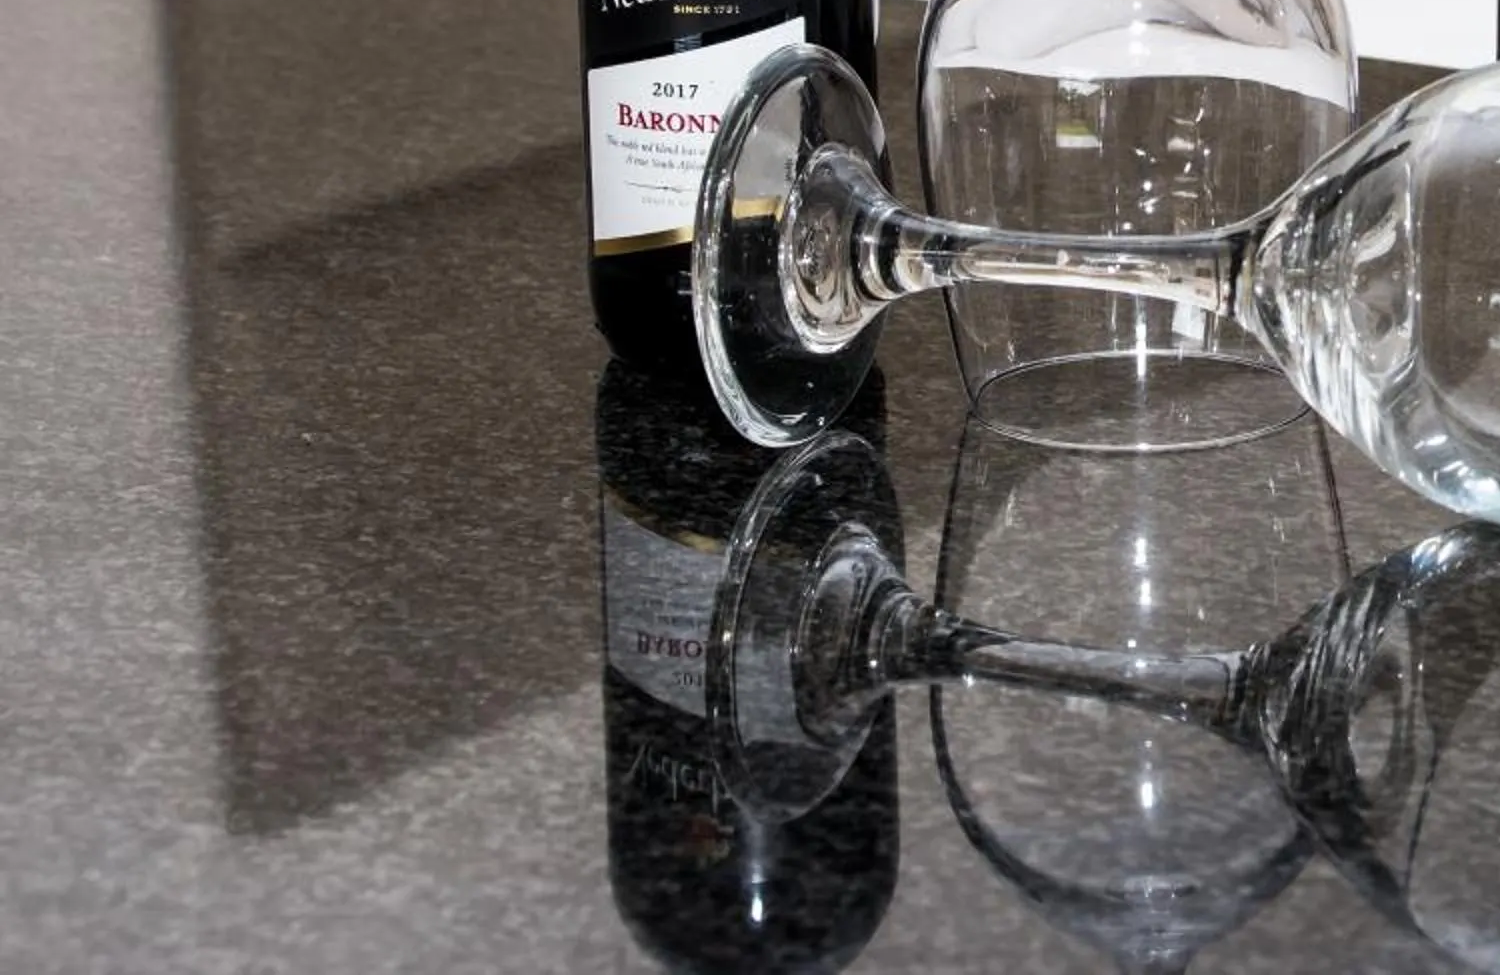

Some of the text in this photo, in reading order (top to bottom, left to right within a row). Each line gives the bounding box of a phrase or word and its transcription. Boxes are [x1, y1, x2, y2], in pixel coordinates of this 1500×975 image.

[673, 4, 710, 14] SINCE
[652, 82, 699, 100] 2017
[618, 102, 722, 134] BARONN
